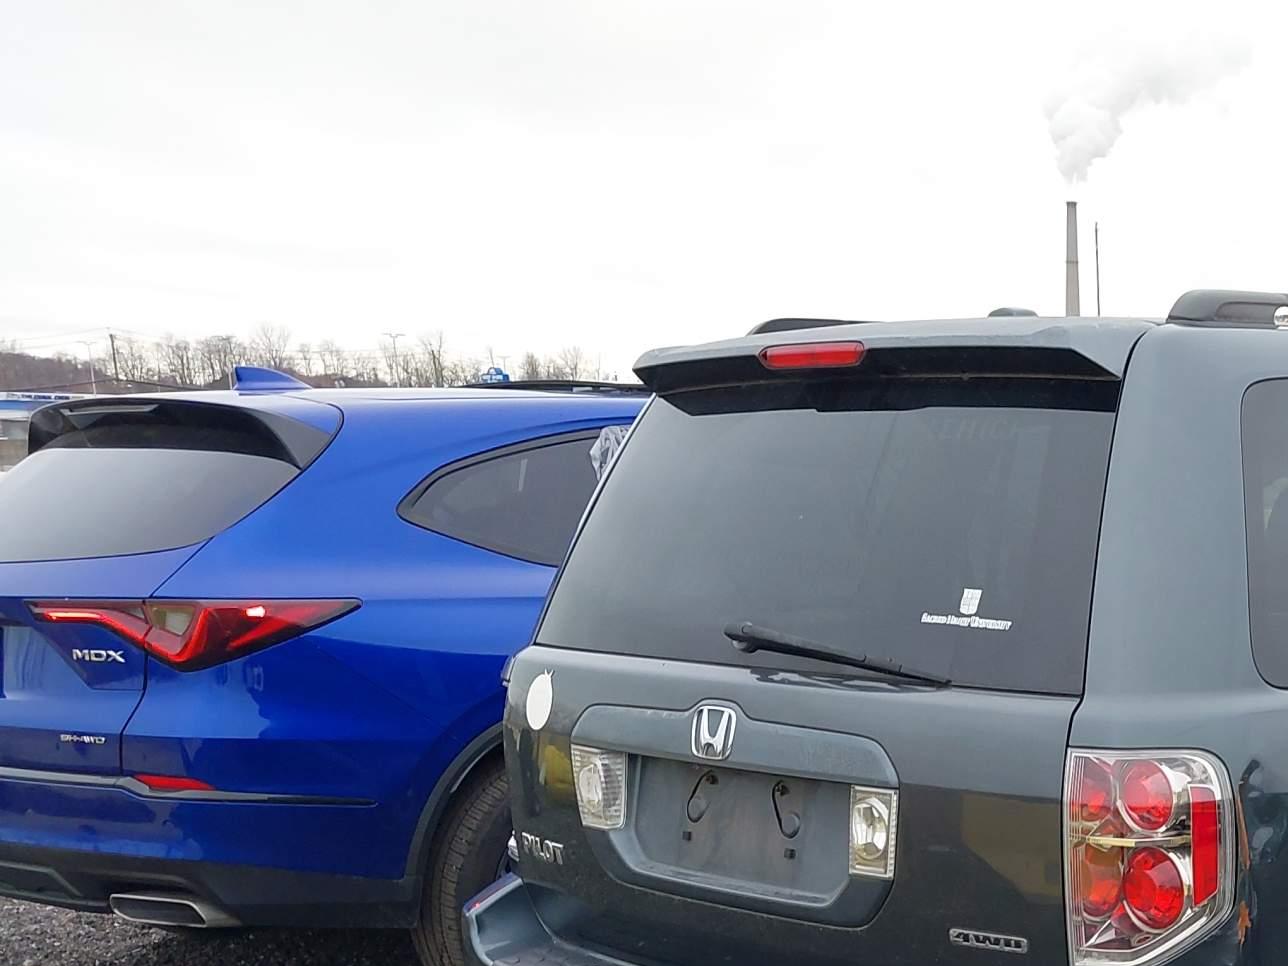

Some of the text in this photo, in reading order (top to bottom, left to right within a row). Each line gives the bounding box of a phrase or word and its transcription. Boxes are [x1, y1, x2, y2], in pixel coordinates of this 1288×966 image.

[72, 648, 126, 663] MDX
[521, 831, 564, 865] PILOT
[949, 929, 1027, 954] 4WD
